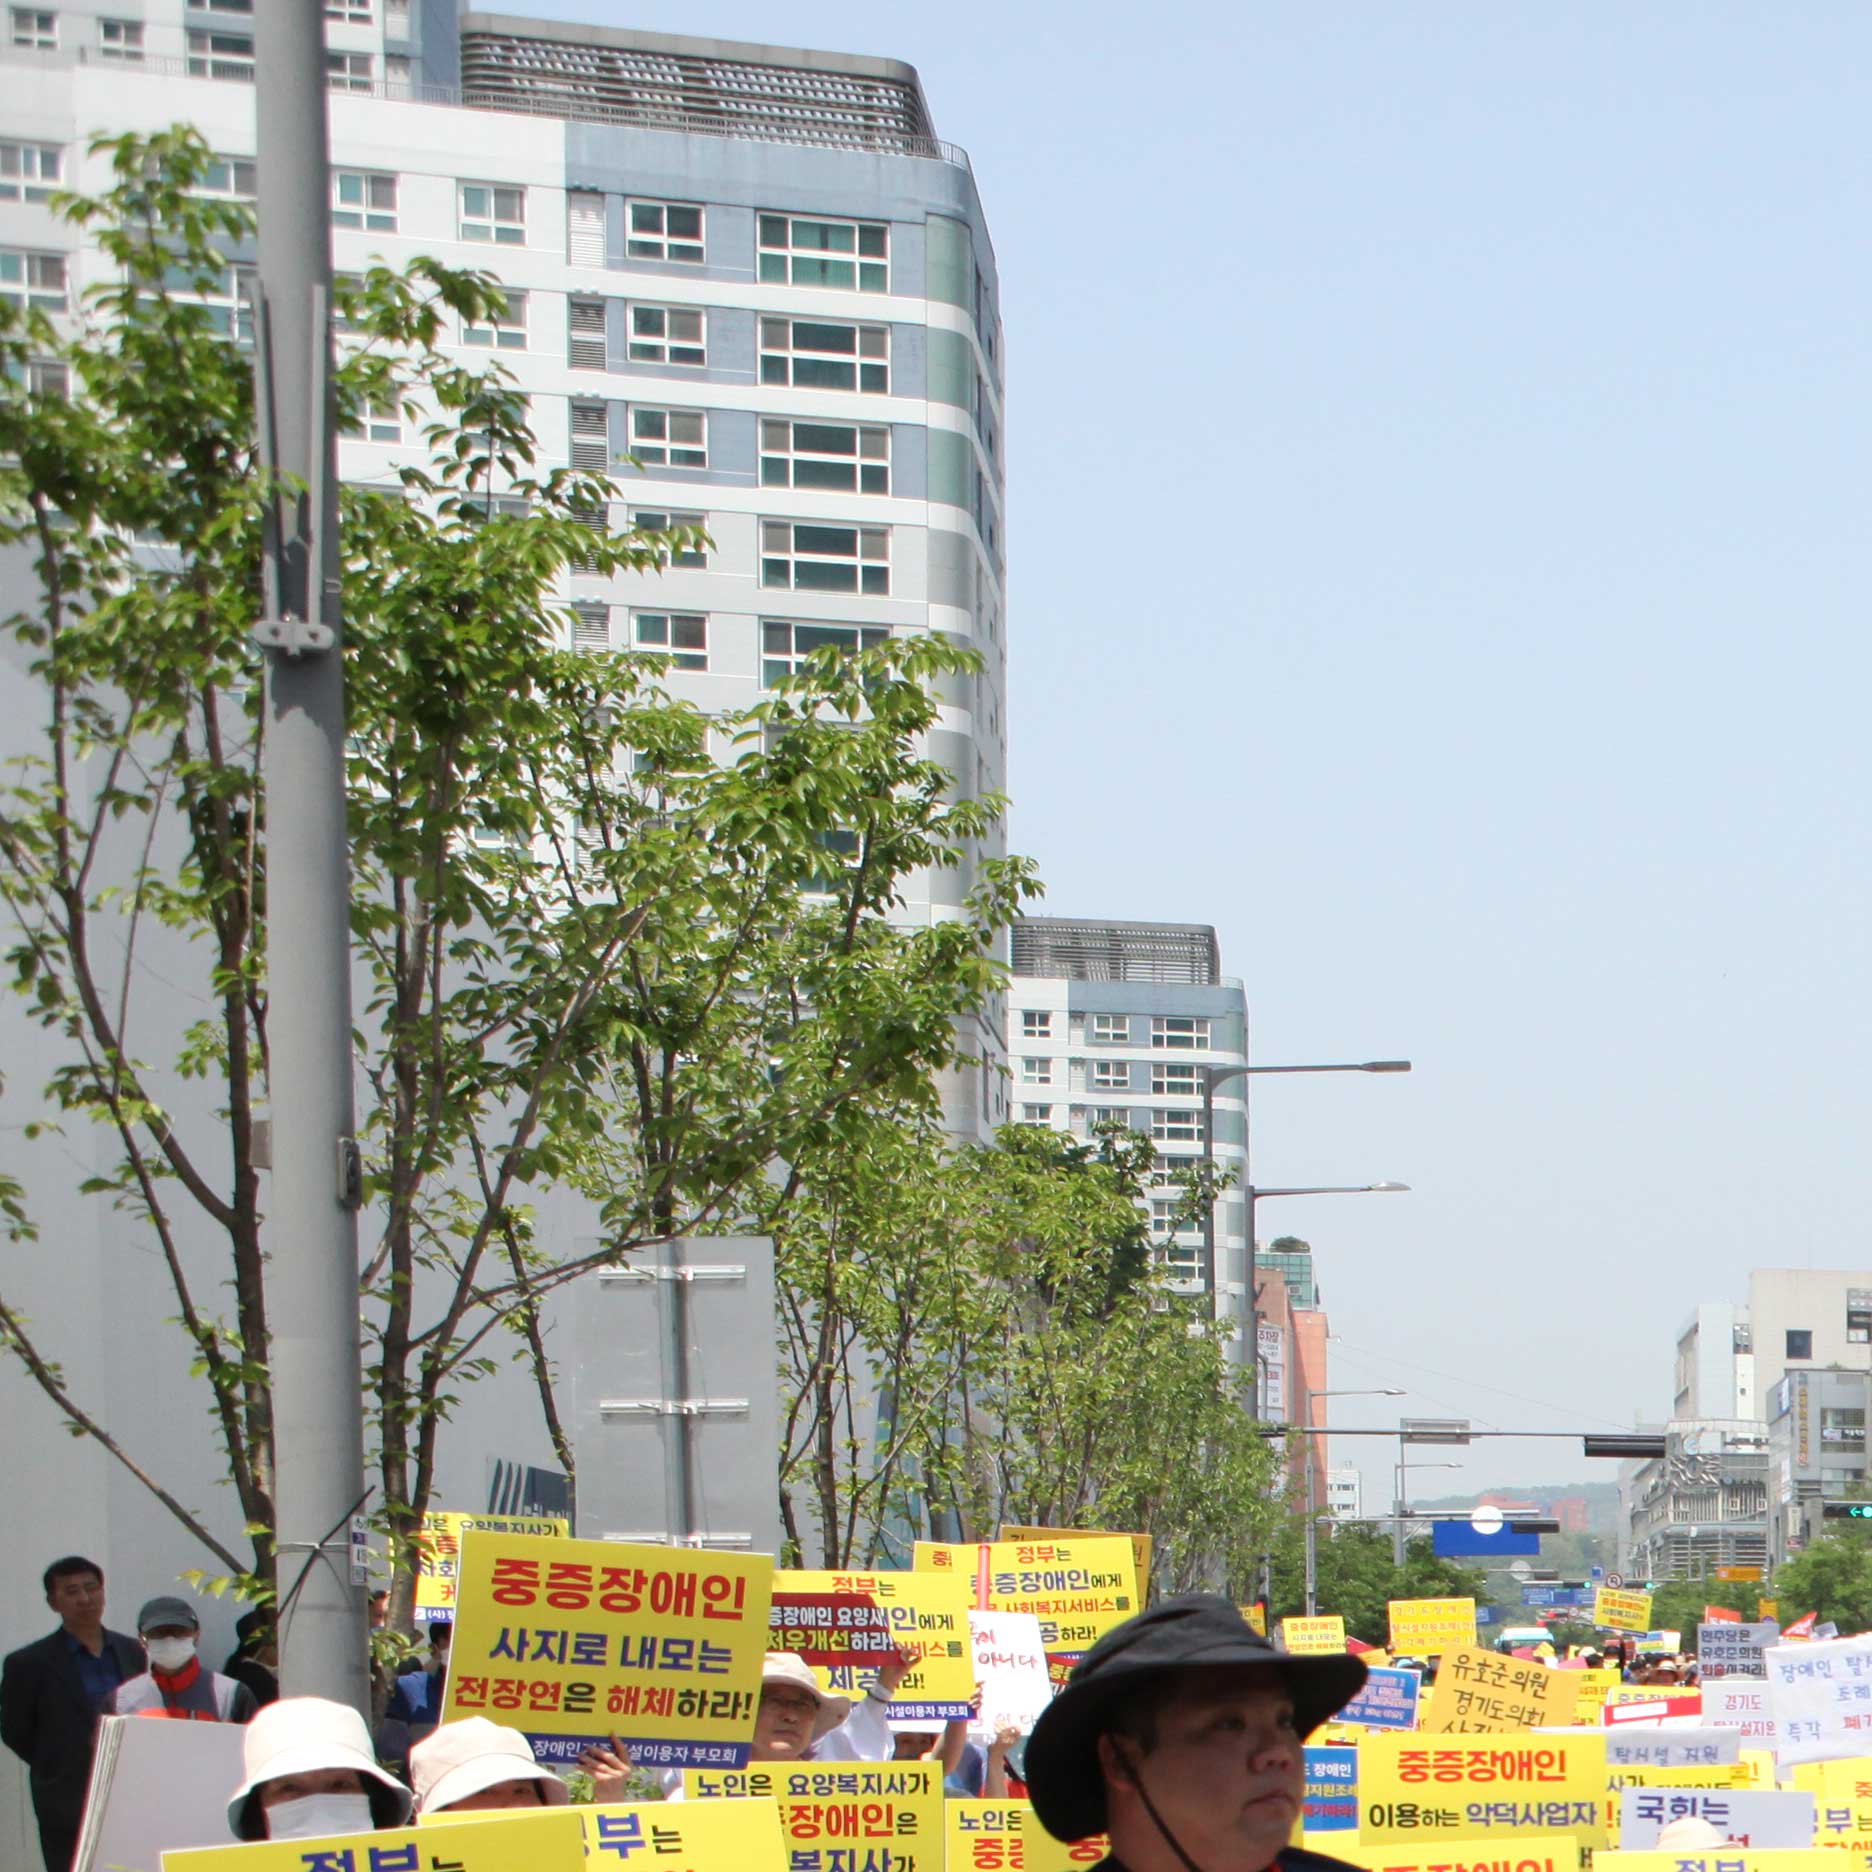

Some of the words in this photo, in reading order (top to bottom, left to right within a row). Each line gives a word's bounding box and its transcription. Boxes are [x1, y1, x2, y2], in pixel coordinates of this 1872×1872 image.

[1016, 1545, 1072, 1564] 정부는
[491, 1558, 745, 1620] 중증장애인
[1702, 1630, 1751, 1642] 민주당은
[489, 1627, 608, 1666] 사지로
[620, 1635, 733, 1674] 내모는
[454, 1676, 596, 1713] 전장연은
[607, 1685, 753, 1720] 해체하라!
[1454, 1688, 1545, 1727] 경기도의회
[1725, 1695, 1762, 1711] 경기도
[1788, 1722, 1821, 1740] 즉각
[692, 1748, 737, 1763] 부모회
[1398, 1750, 1566, 1782] 중증장애인
[698, 1775, 772, 1798] 노인은
[788, 1773, 929, 1796] 요양복지사가
